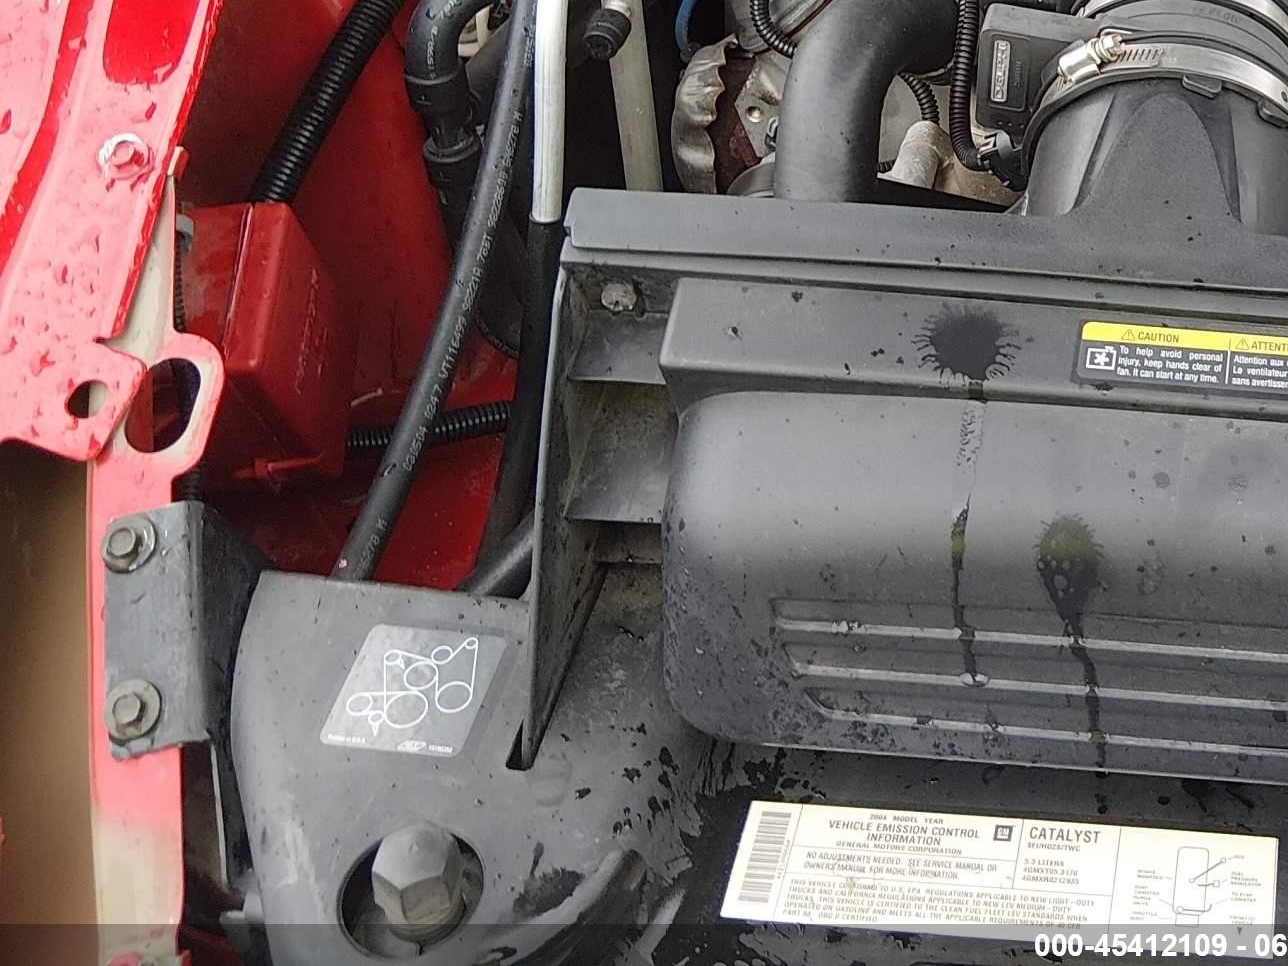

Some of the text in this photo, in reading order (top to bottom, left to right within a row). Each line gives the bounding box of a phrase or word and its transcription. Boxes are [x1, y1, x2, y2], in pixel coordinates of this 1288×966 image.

[995, 42, 1008, 100] DELPHI
[1138, 332, 1179, 343] CAUTION
[1120, 346, 1223, 363] To help avoid personal
[1234, 355, 1267, 365] Attention
[1118, 356, 1222, 372] injury, keep hands clear of
[1117, 367, 1131, 376] fan.
[1133, 368, 1138, 377] It
[1156, 370, 1173, 379] start
[1175, 372, 1182, 380] at
[1184, 374, 1198, 383] any
[1200, 374, 1218, 383] time.
[1233, 366, 1242, 374] Le
[1247, 367, 1288, 378] ventilateur
[893, 815, 918, 823] MODEL
[829, 820, 980, 838] VEHICLE EMISSION CONTROL
[1029, 826, 1101, 843] CATALYST
[867, 833, 941, 846] INFORMATION
[836, 841, 962, 855] GENERAL MOTORS CORPORATION
[806, 851, 817, 859] NO
[818, 852, 871, 863] ADJUSTMENTS
[908, 858, 921, 867] SEE
[923, 859, 953, 869] SERVICE
[955, 861, 984, 871] MANUAL
[987, 863, 997, 872] OR
[869, 866, 883, 874] FOR
[885, 867, 905, 876] MORE
